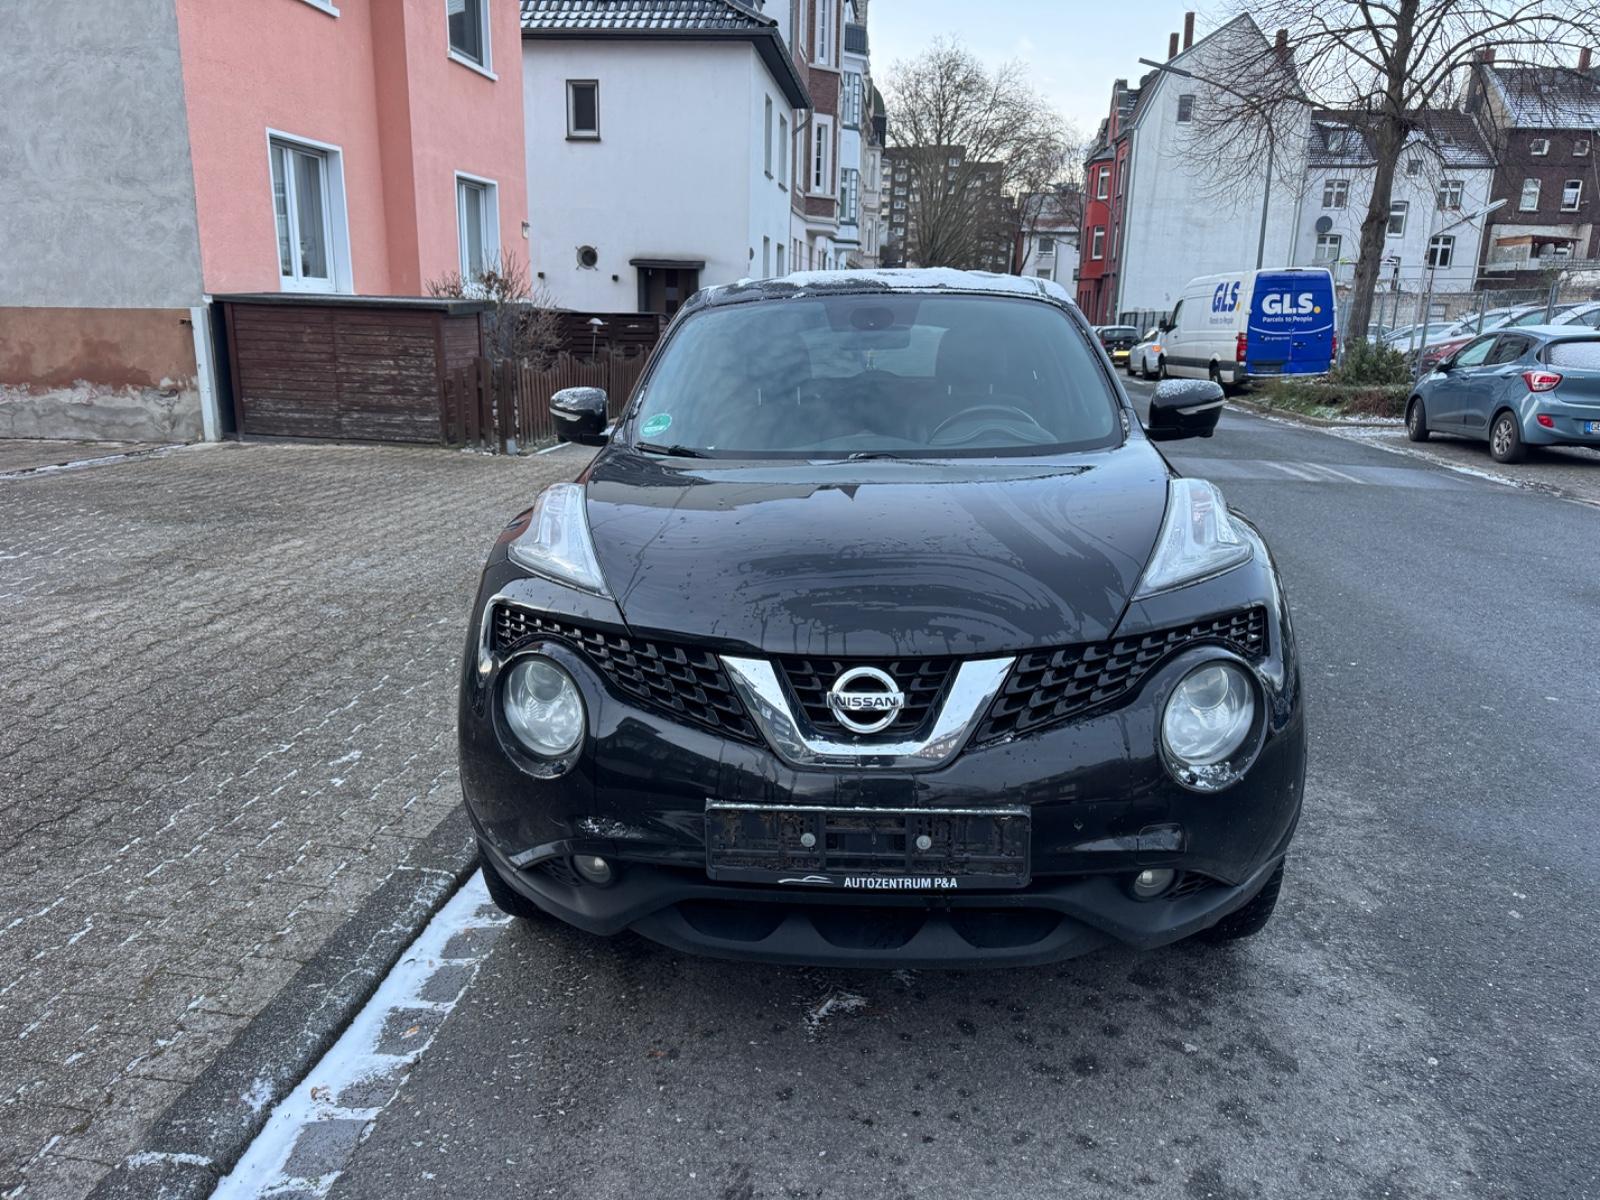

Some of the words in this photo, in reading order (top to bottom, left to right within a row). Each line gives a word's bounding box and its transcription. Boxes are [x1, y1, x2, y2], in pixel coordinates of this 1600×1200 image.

[1293, 315, 1312, 323] People
[835, 696, 896, 707] NISSAN
[844, 877, 931, 889] AUTOZENTRUM
[934, 878, 958, 888] P&A
